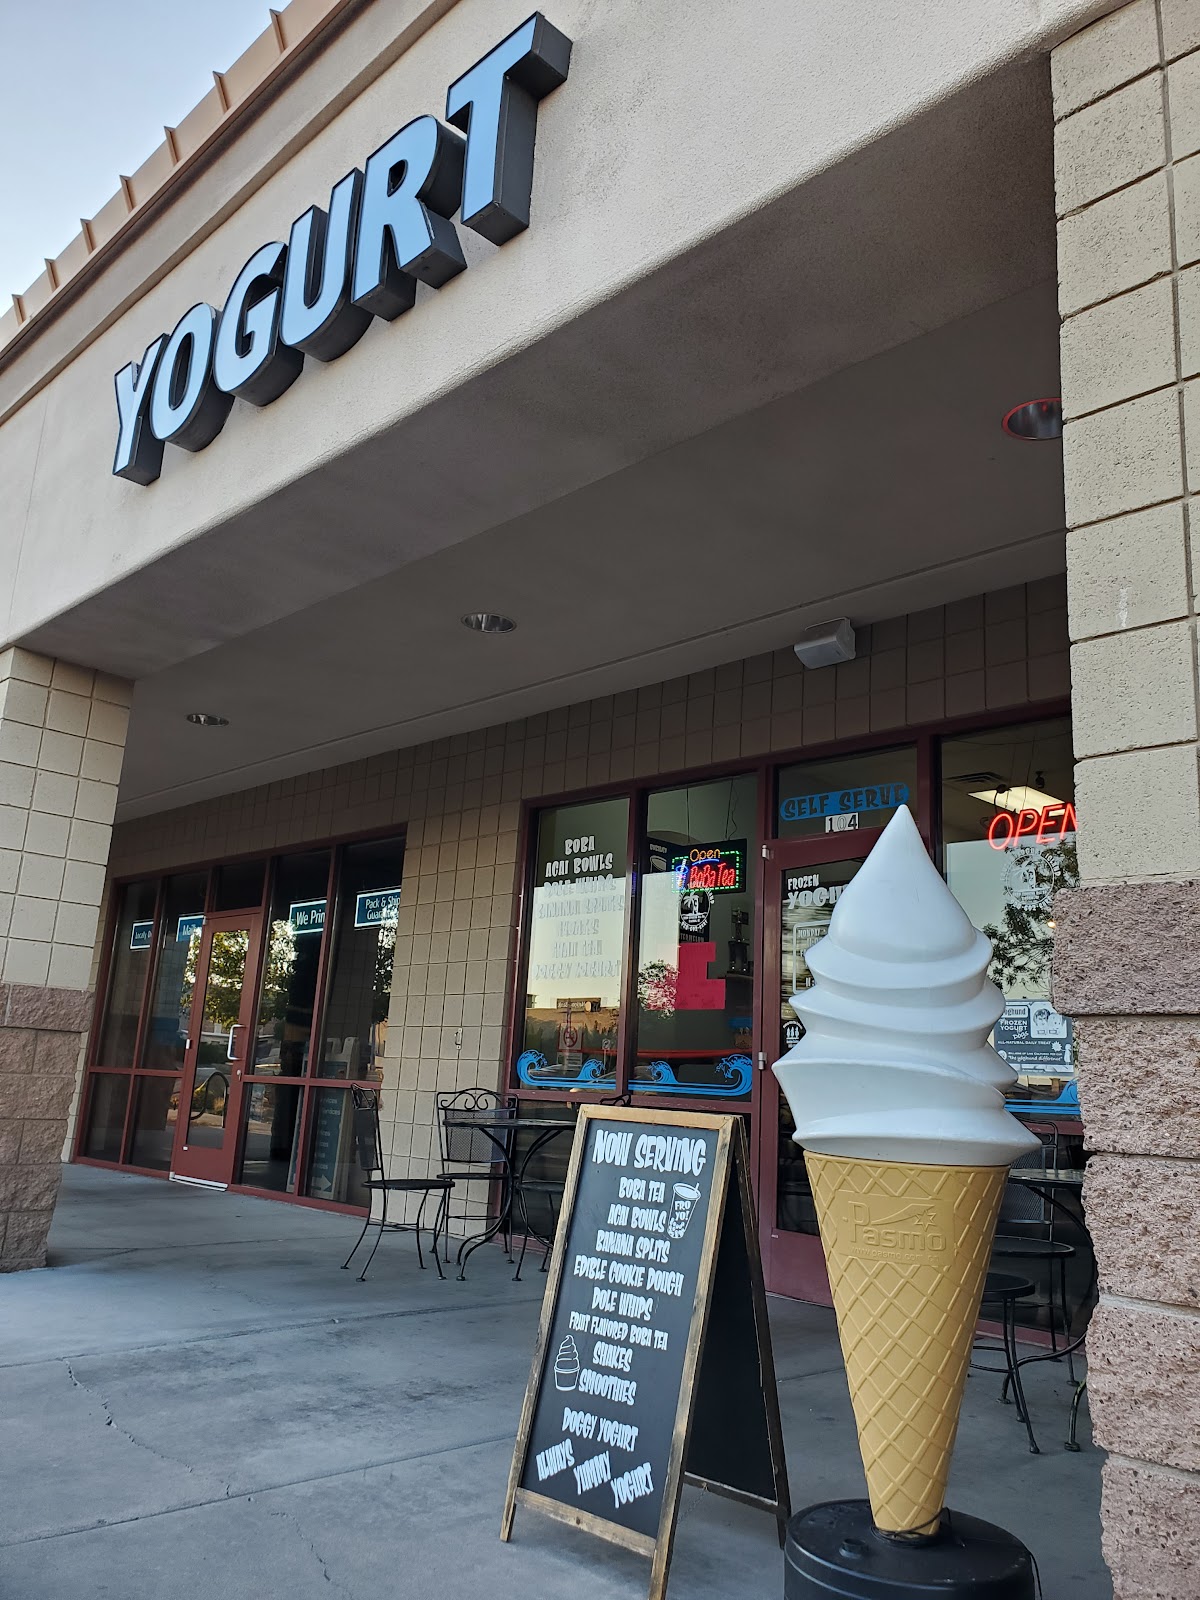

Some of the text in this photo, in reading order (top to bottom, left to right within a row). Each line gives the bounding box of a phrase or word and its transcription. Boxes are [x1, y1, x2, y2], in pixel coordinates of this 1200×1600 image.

[113, 11, 572, 486] YOGURT
[784, 784, 905, 818] SELF SERVE
[827, 814, 858, 832] 104
[564, 836, 596, 855] BOBA
[689, 848, 721, 862] Open
[545, 852, 613, 878] ACAI BOWLS
[717, 863, 735, 886] Tea
[787, 874, 820, 890] FROZEN
[788, 884, 849, 909] YOGU
[296, 909, 325, 925] We Prin
[365, 899, 379, 909] Pack
[381, 897, 386, 907] &
[592, 1129, 706, 1176] NOW SERVING
[619, 1177, 665, 1203] BOBA TEA
[607, 1203, 667, 1233] ACAI BOWLS
[675, 1200, 691, 1211] FRO
[675, 1211, 690, 1221] YO!
[848, 1201, 946, 1252] Pasmo
[596, 1230, 670, 1263] BANANA SPLITS
[573, 1255, 685, 1297] EDIBLE COOKIE DOUGH
[592, 1287, 654, 1321] DOLE WHIPS
[568, 1311, 669, 1350] FRUIT FLAVORED BOBA TEA
[593, 1341, 633, 1372] SHAKES
[578, 1369, 637, 1405] SMOOTHIES
[562, 1407, 639, 1452] DOGGY YOGURT
[536, 1438, 654, 1509] ALWAYS YUMMY YOGURT
